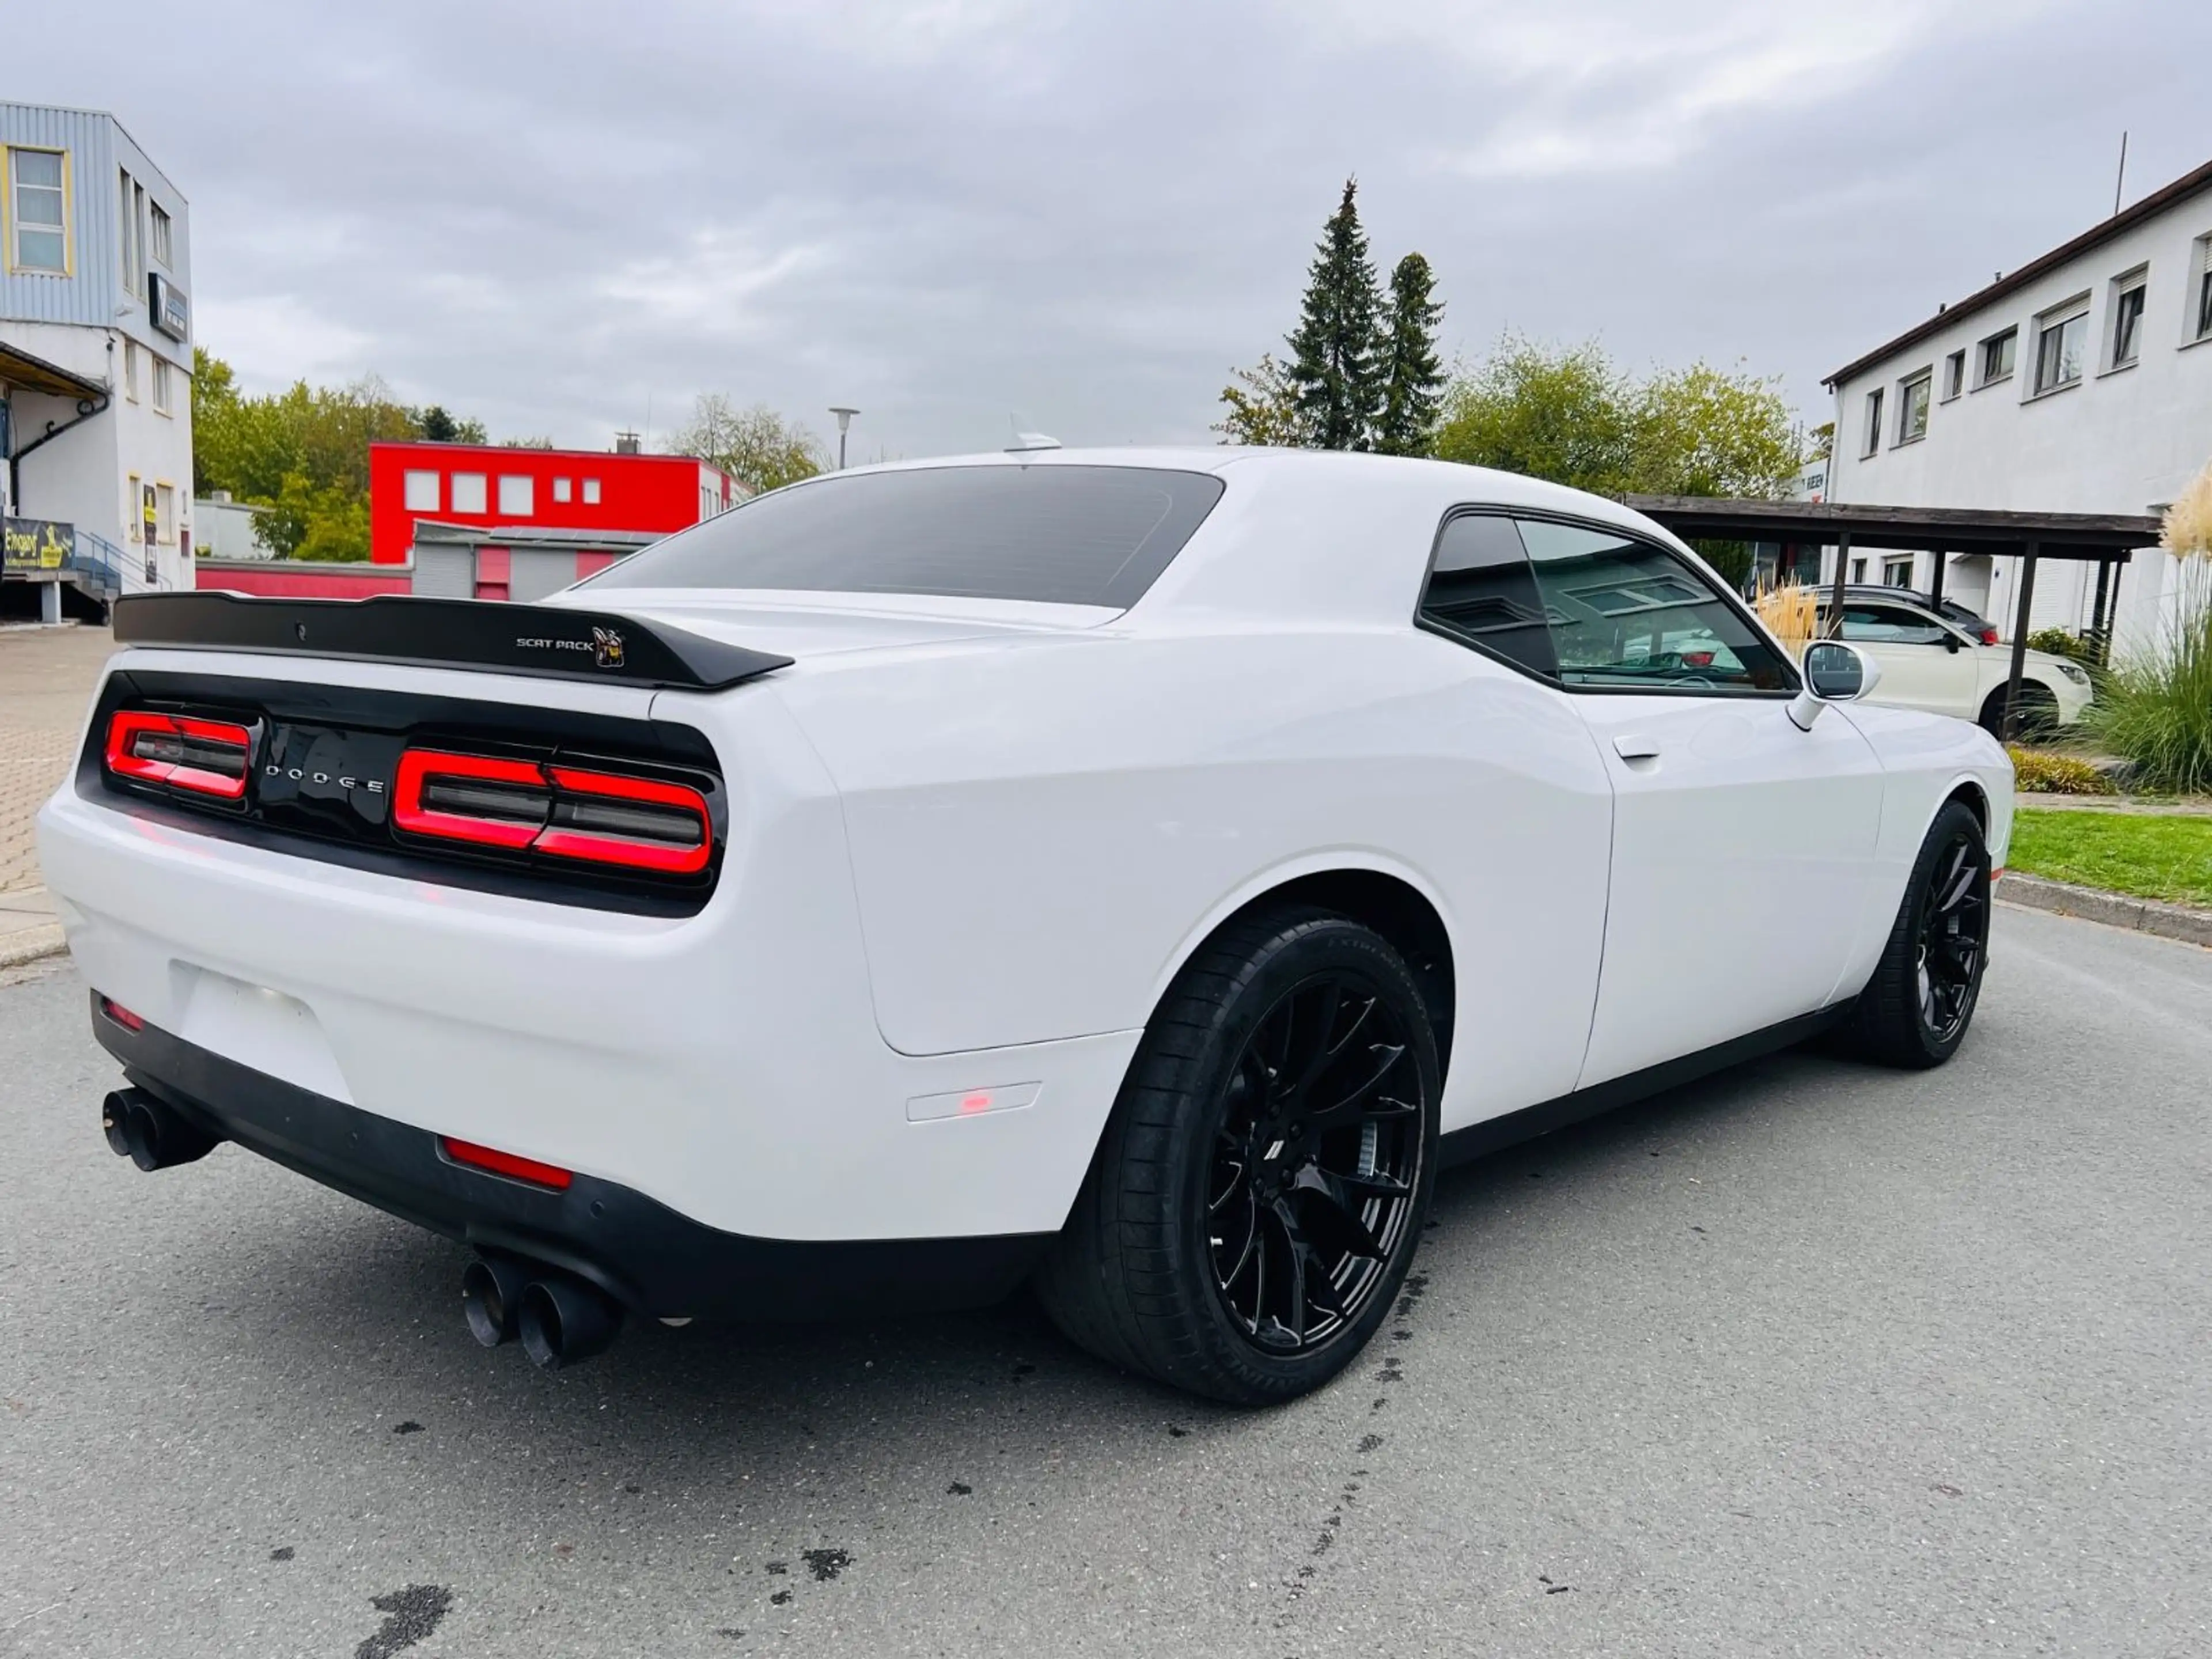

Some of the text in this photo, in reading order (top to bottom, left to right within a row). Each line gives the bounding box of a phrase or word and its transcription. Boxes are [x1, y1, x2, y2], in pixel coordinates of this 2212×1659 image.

[516, 638, 594, 652] SCAT PACK
[266, 765, 384, 793] DODGE
